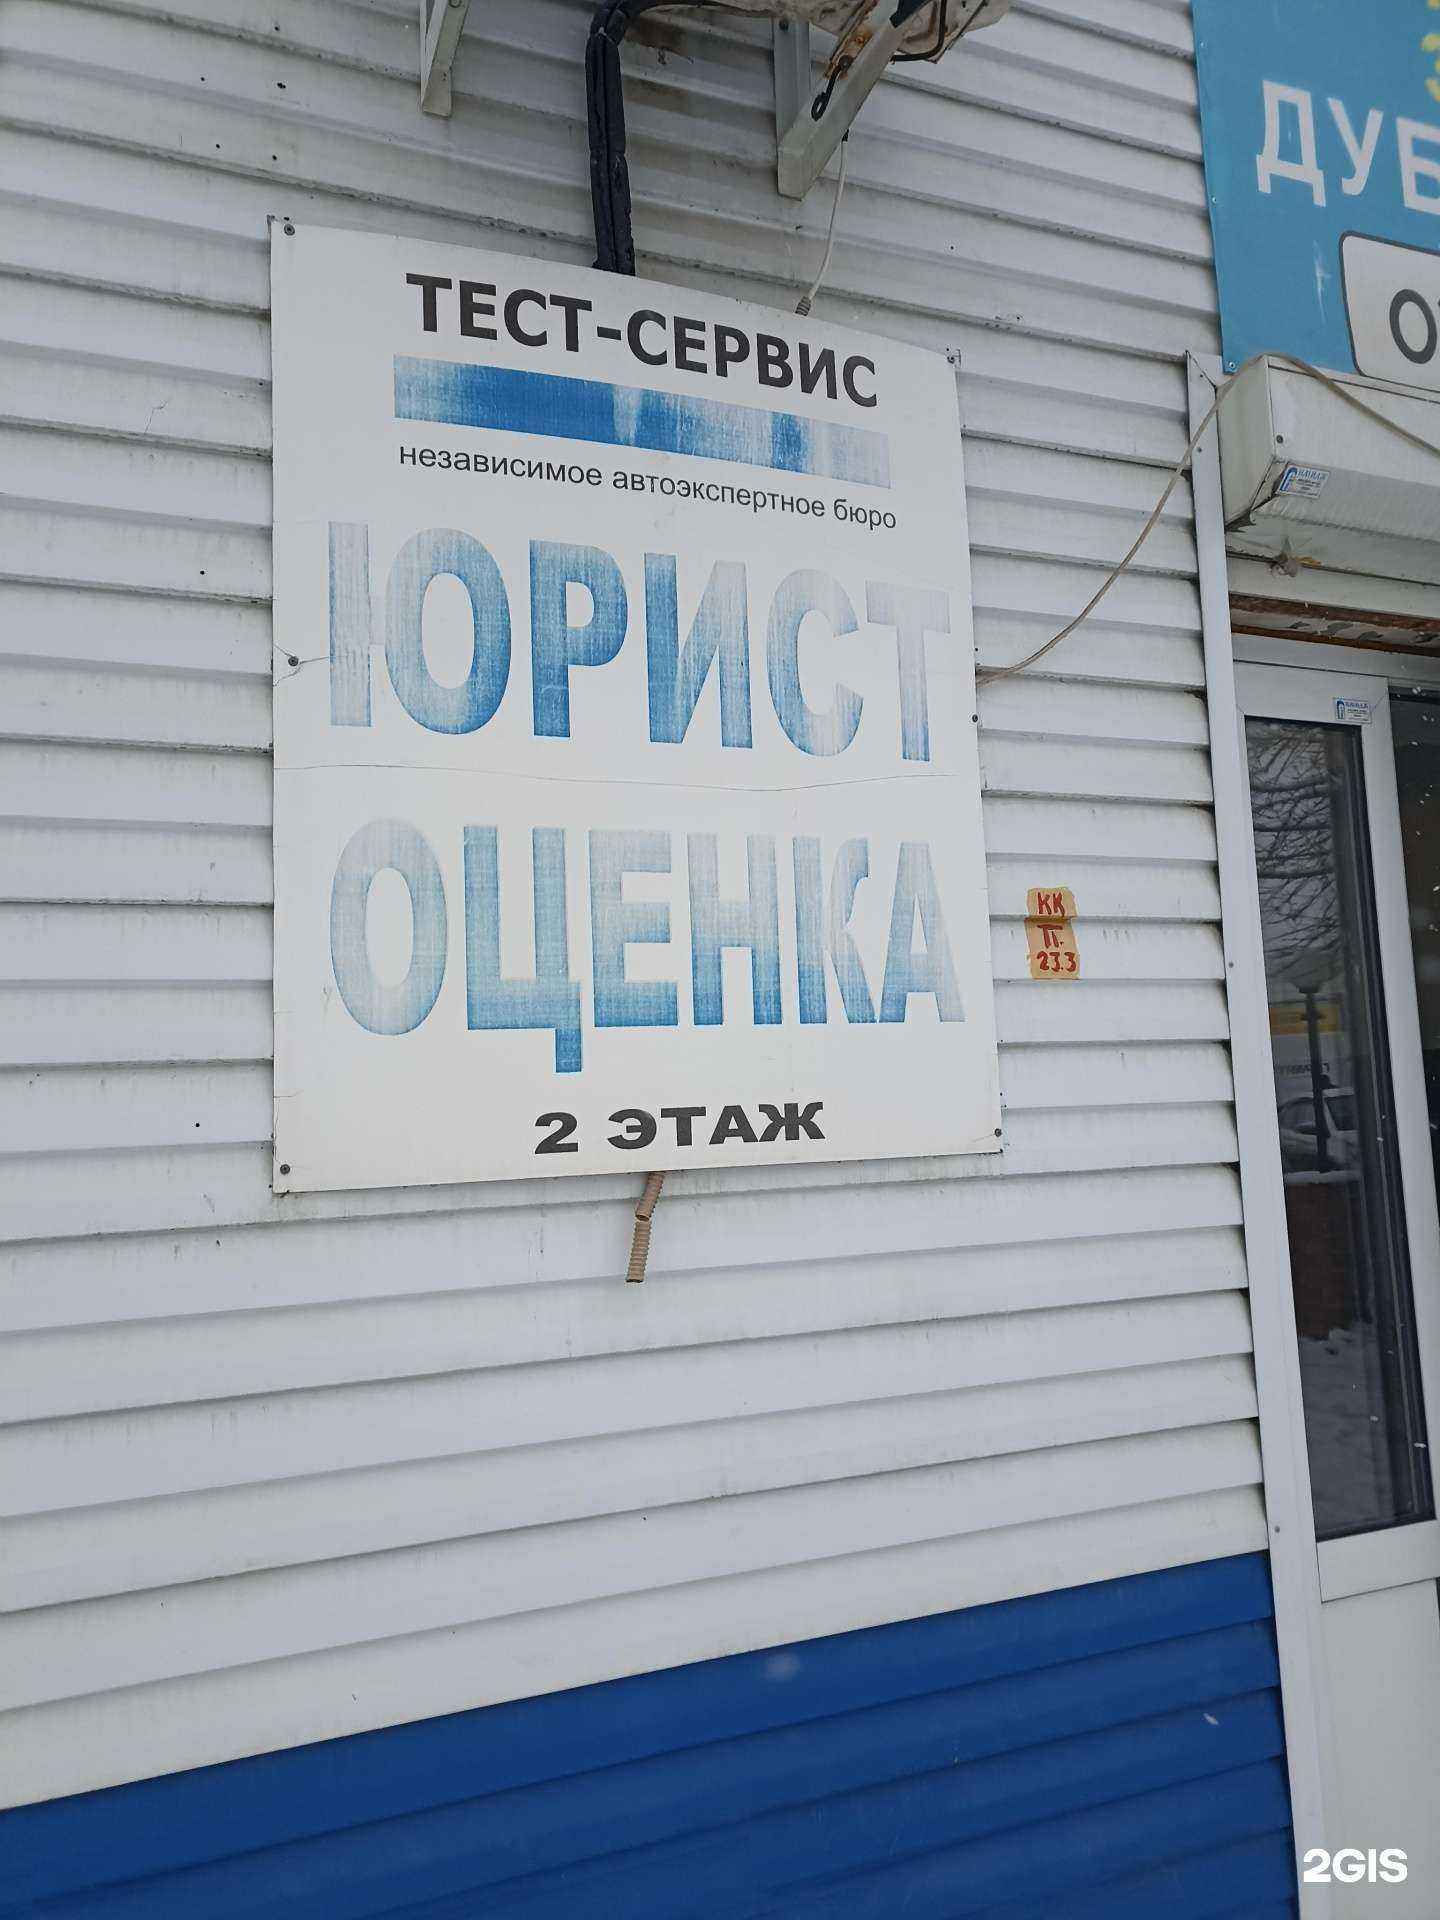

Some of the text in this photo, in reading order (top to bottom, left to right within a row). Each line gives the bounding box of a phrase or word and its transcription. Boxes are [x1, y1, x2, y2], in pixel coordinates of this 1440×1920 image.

[405, 272, 878, 408] ТЕСТ-СЕРВИС
[400, 446, 897, 530] независимое автоэкспертное бюро
[328, 521, 951, 763] ЮРИСТ
[329, 817, 966, 1073] ОЦЕНКА
[534, 1101, 826, 1154] 2 ЭТАЖ
